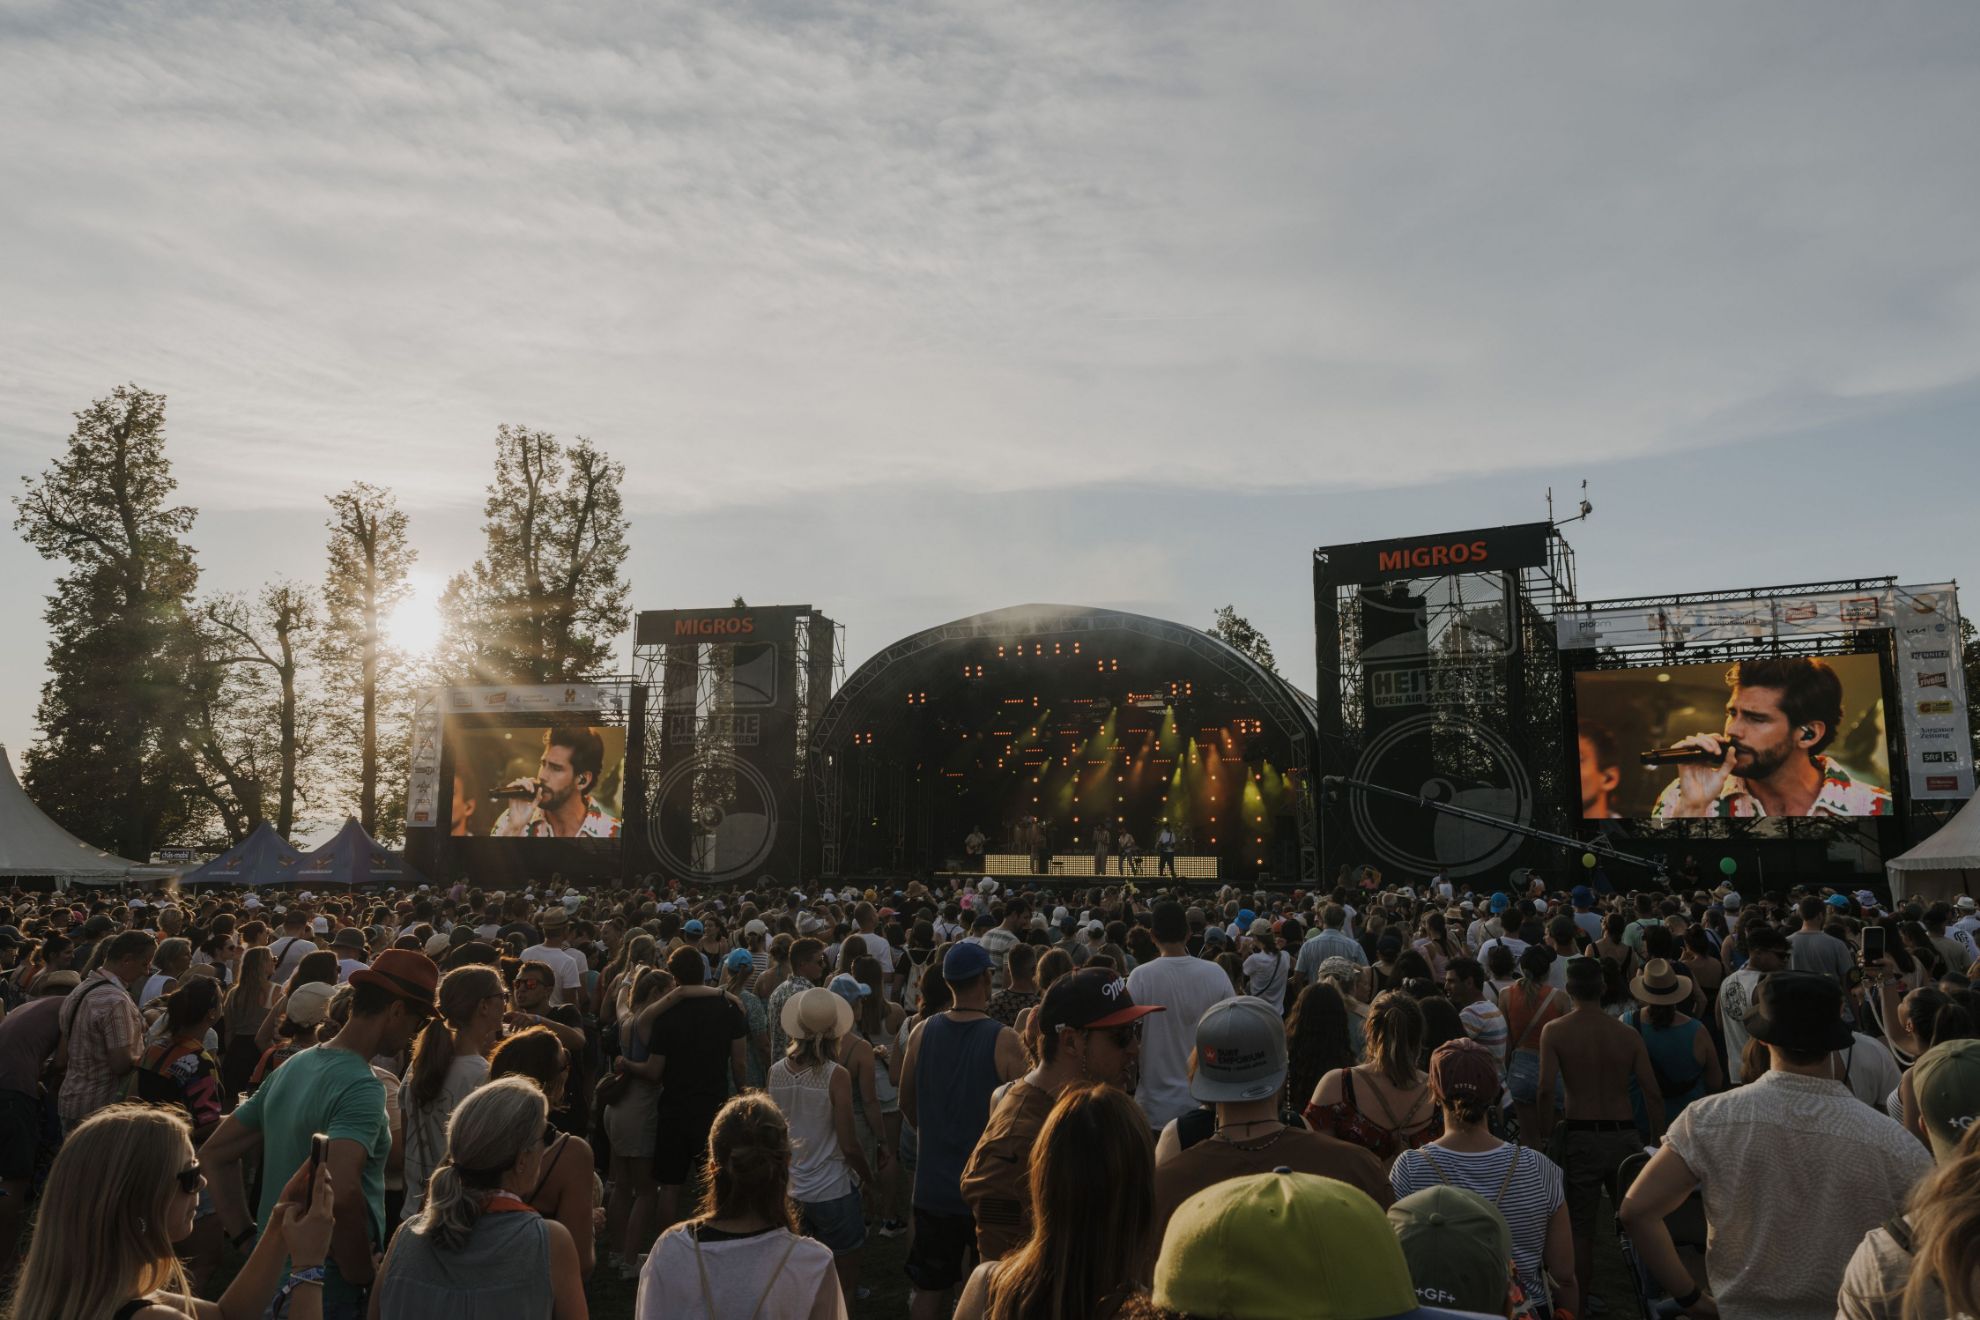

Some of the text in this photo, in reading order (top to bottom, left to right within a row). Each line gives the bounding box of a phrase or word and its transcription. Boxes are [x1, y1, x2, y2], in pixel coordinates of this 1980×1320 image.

[1379, 540, 1489, 572] MIGROS
[675, 617, 753, 636] MIGROS
[1375, 695, 1403, 706] OPEN
[1404, 693, 1423, 704] AIR
[1924, 753, 1941, 762] SRF
